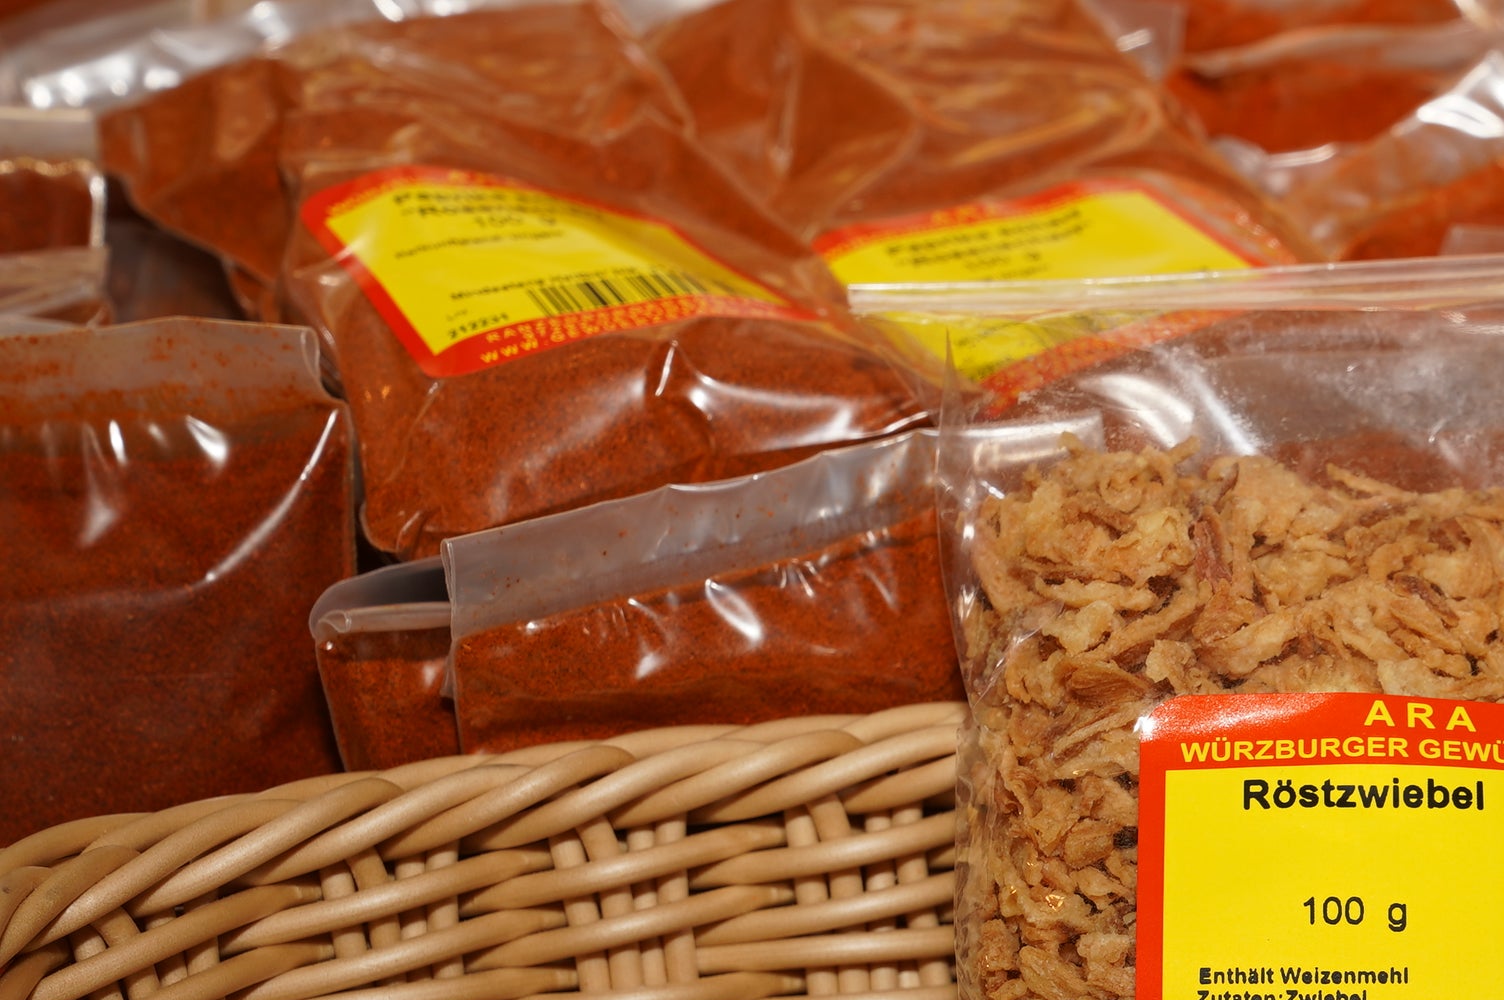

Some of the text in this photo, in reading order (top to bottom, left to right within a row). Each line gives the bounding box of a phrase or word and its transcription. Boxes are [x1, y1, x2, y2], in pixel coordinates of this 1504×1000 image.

[1363, 699, 1478, 733] ARA
[1180, 735, 1411, 763] WÜRZBURGER
[1243, 777, 1485, 811] Röstzwiebel
[1303, 896, 1408, 933] 100 g
[1199, 966, 1409, 985] Enthält Weizenmehl
